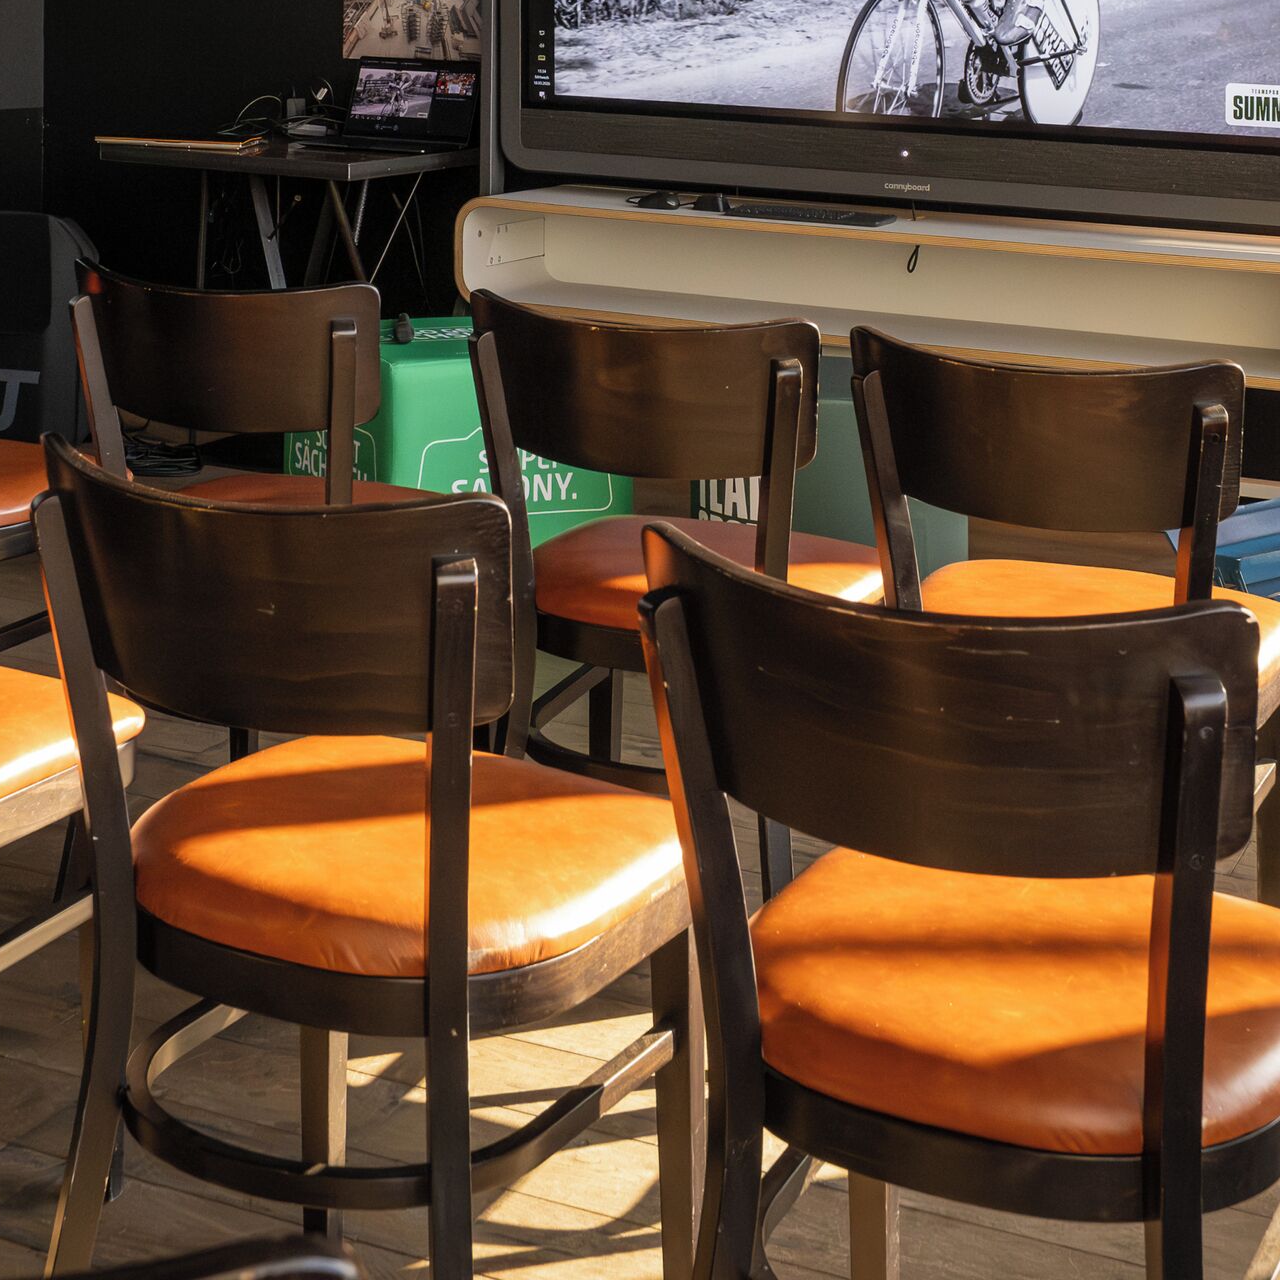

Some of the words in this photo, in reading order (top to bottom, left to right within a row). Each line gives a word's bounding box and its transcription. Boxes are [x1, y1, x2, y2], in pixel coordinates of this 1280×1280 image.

[884, 182, 931, 193] cannyboard
[478, 447, 558, 474] SPL
[451, 472, 577, 502] SANY.
